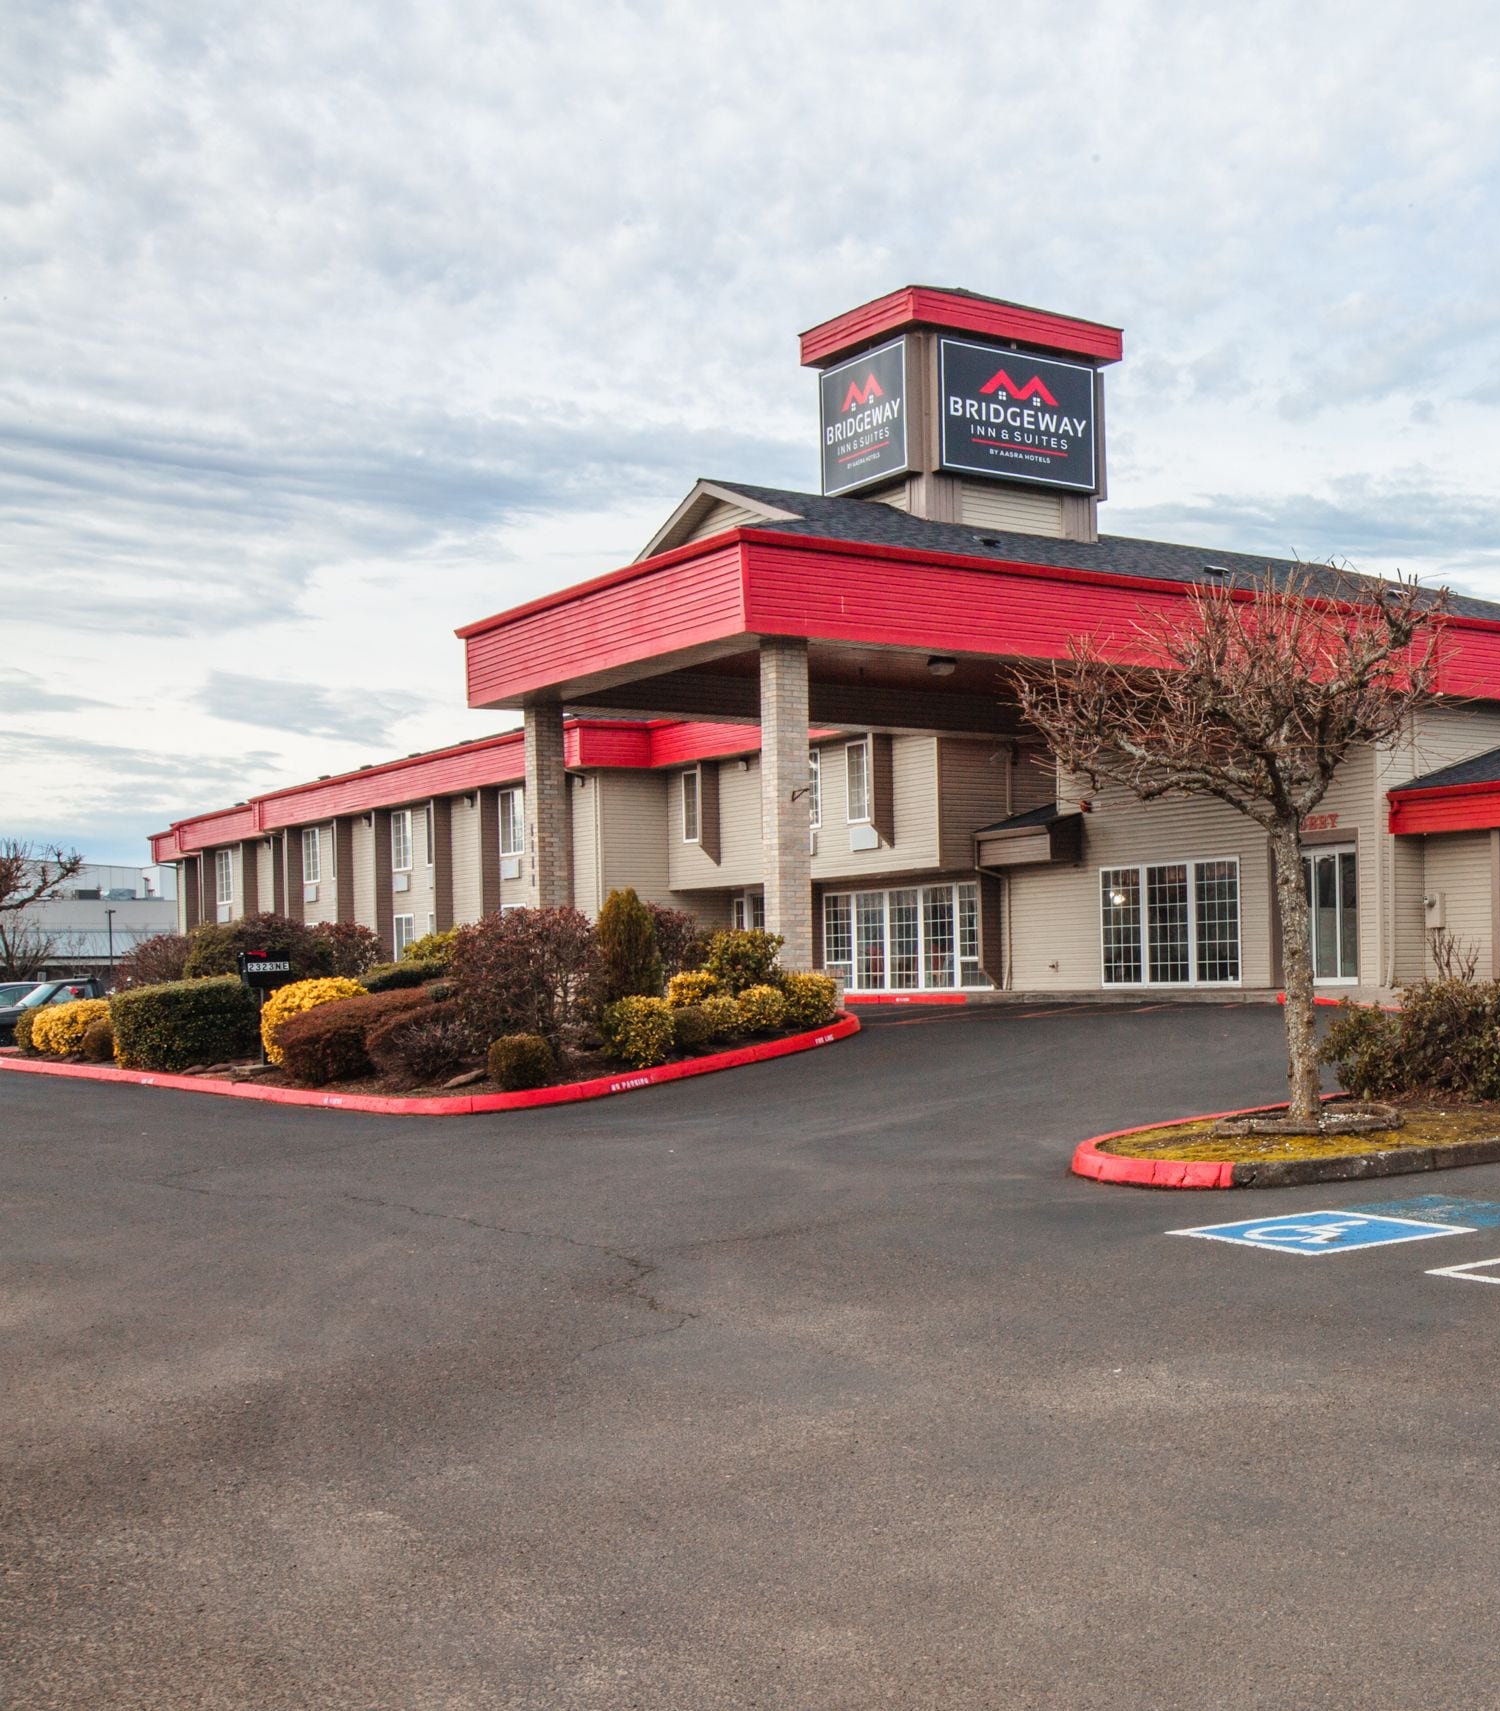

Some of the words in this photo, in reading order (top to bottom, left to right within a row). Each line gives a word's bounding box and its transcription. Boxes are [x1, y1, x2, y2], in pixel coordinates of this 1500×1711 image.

[826, 397, 900, 446] BRIDGEWAY
[949, 395, 1087, 438] BRIDGEWAY
[837, 441, 851, 457] INN
[853, 439, 859, 450] &
[860, 426, 890, 447] SUITES
[970, 423, 996, 438] INN
[1001, 429, 1009, 440] &
[1013, 431, 1068, 450] SUITES
[989, 448, 998, 456] BY
[999, 450, 1024, 460] AASRA
[1024, 454, 1051, 464] HOTELS
[621, 1077, 649, 1089] PARKING
